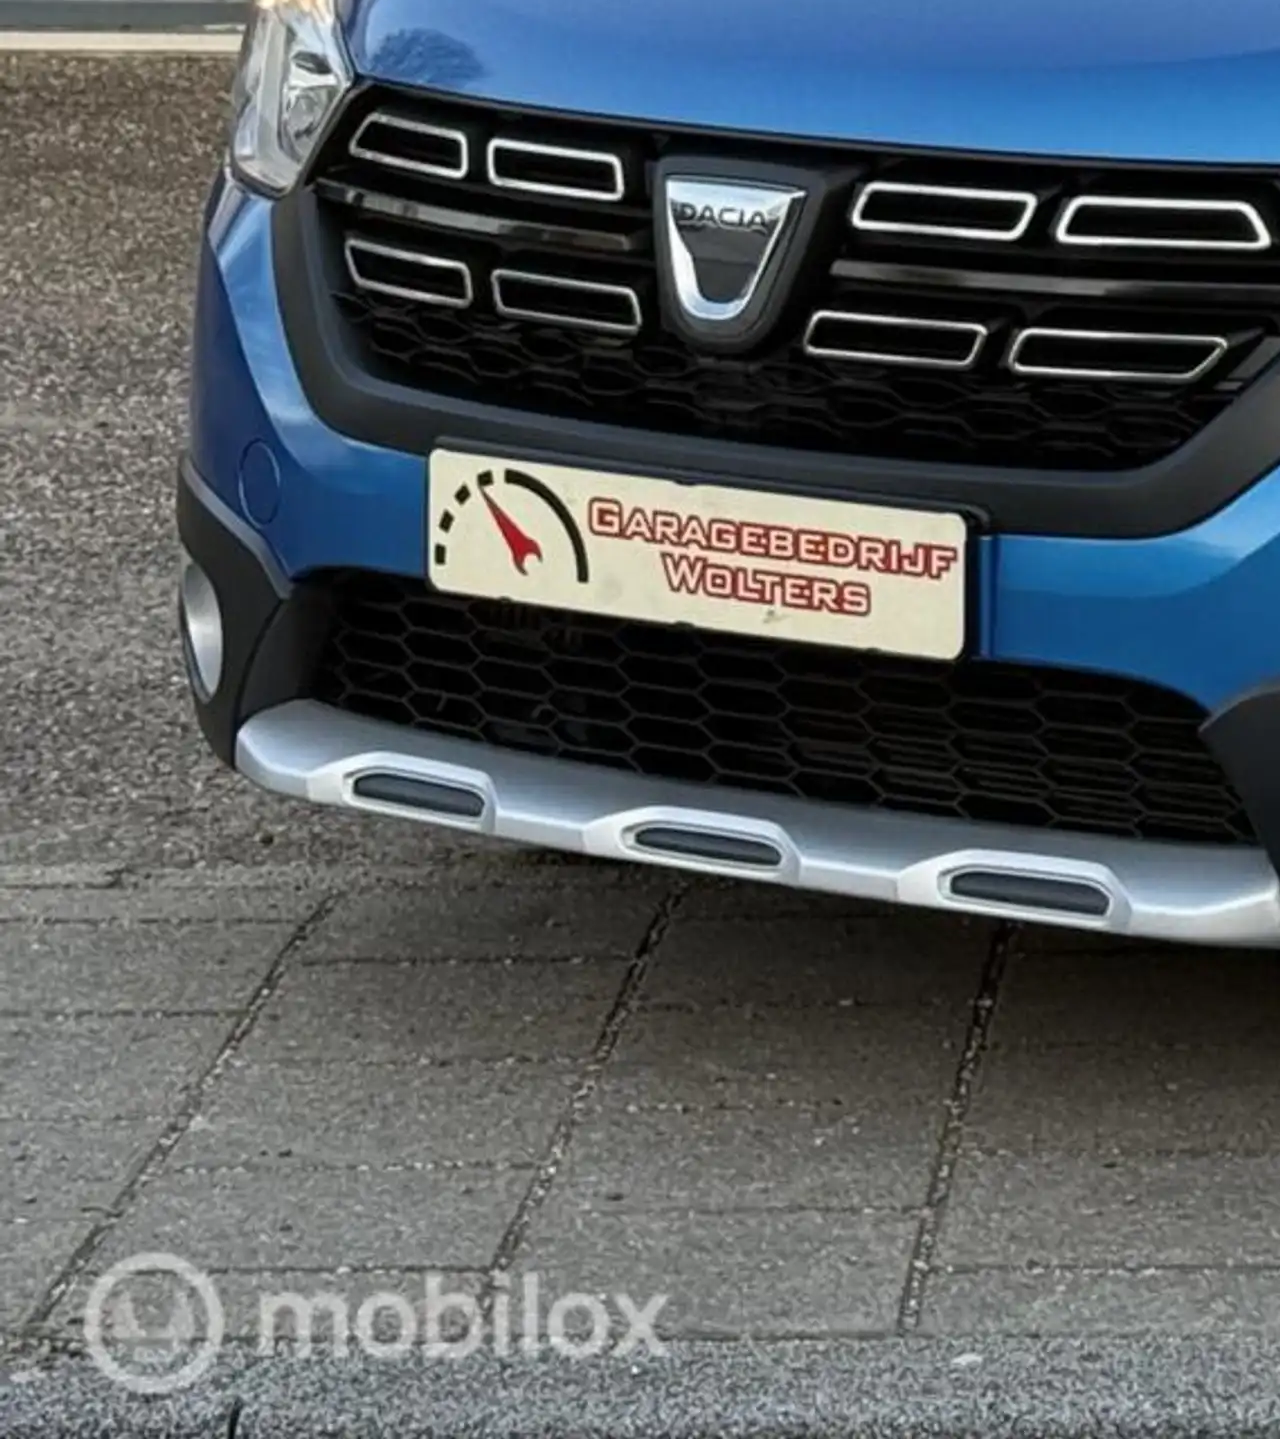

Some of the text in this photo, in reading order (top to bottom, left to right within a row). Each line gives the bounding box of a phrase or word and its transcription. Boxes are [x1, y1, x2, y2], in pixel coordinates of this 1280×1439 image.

[676, 201, 769, 233] DACIA
[588, 498, 957, 579] GARAGEBEDRIJF
[661, 552, 871, 616] WOLTERS
